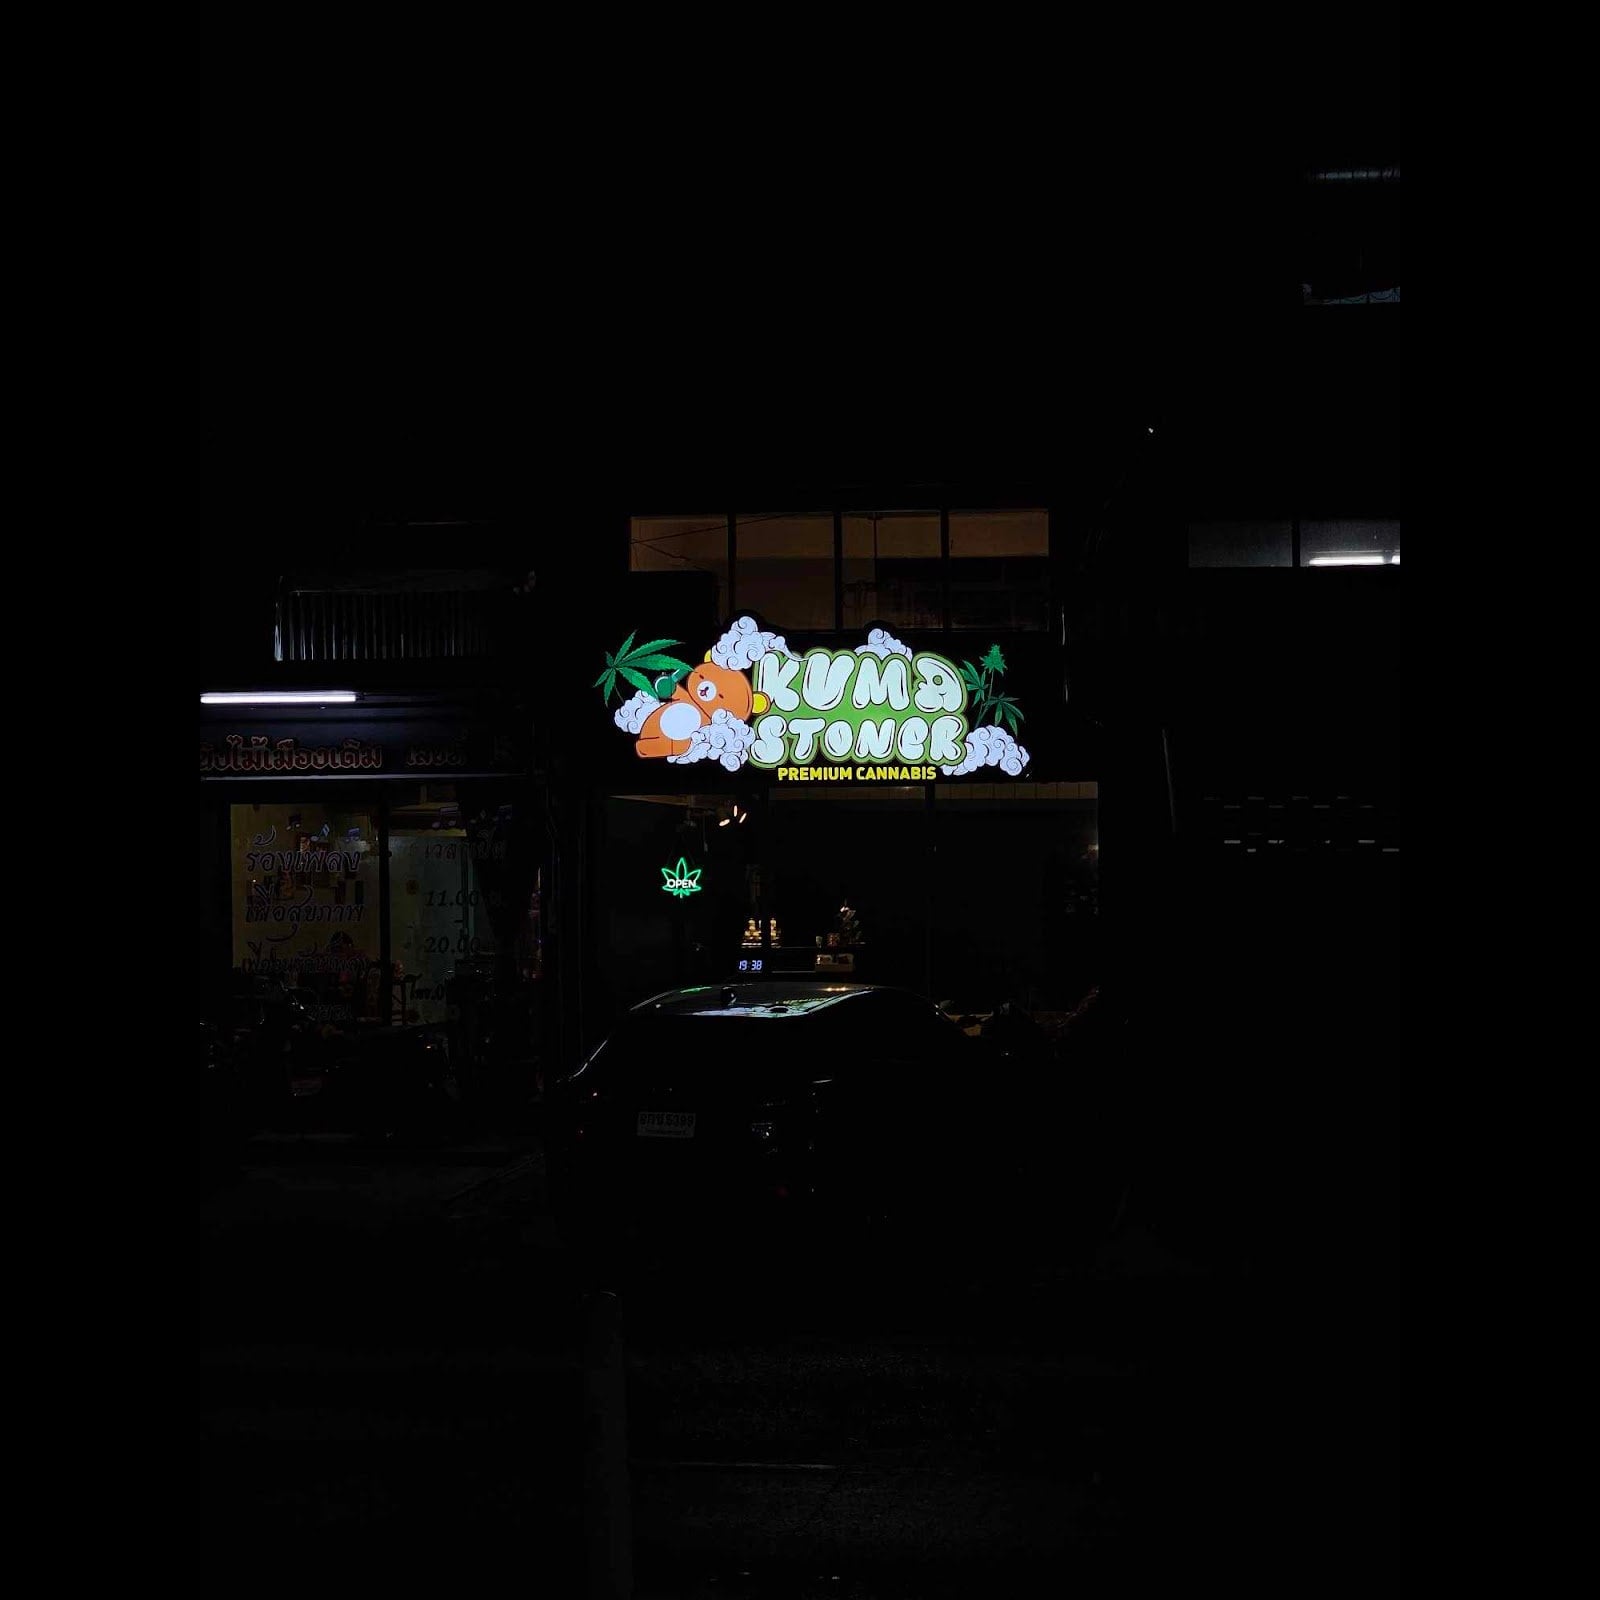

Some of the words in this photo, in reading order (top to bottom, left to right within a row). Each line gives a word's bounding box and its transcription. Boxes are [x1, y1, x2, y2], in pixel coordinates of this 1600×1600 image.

[758, 652, 963, 713] KUMA
[750, 715, 964, 764] STONER
[777, 767, 852, 781] PREMIUM
[856, 766, 937, 780] CANNABIS
[666, 877, 698, 889] OPEN
